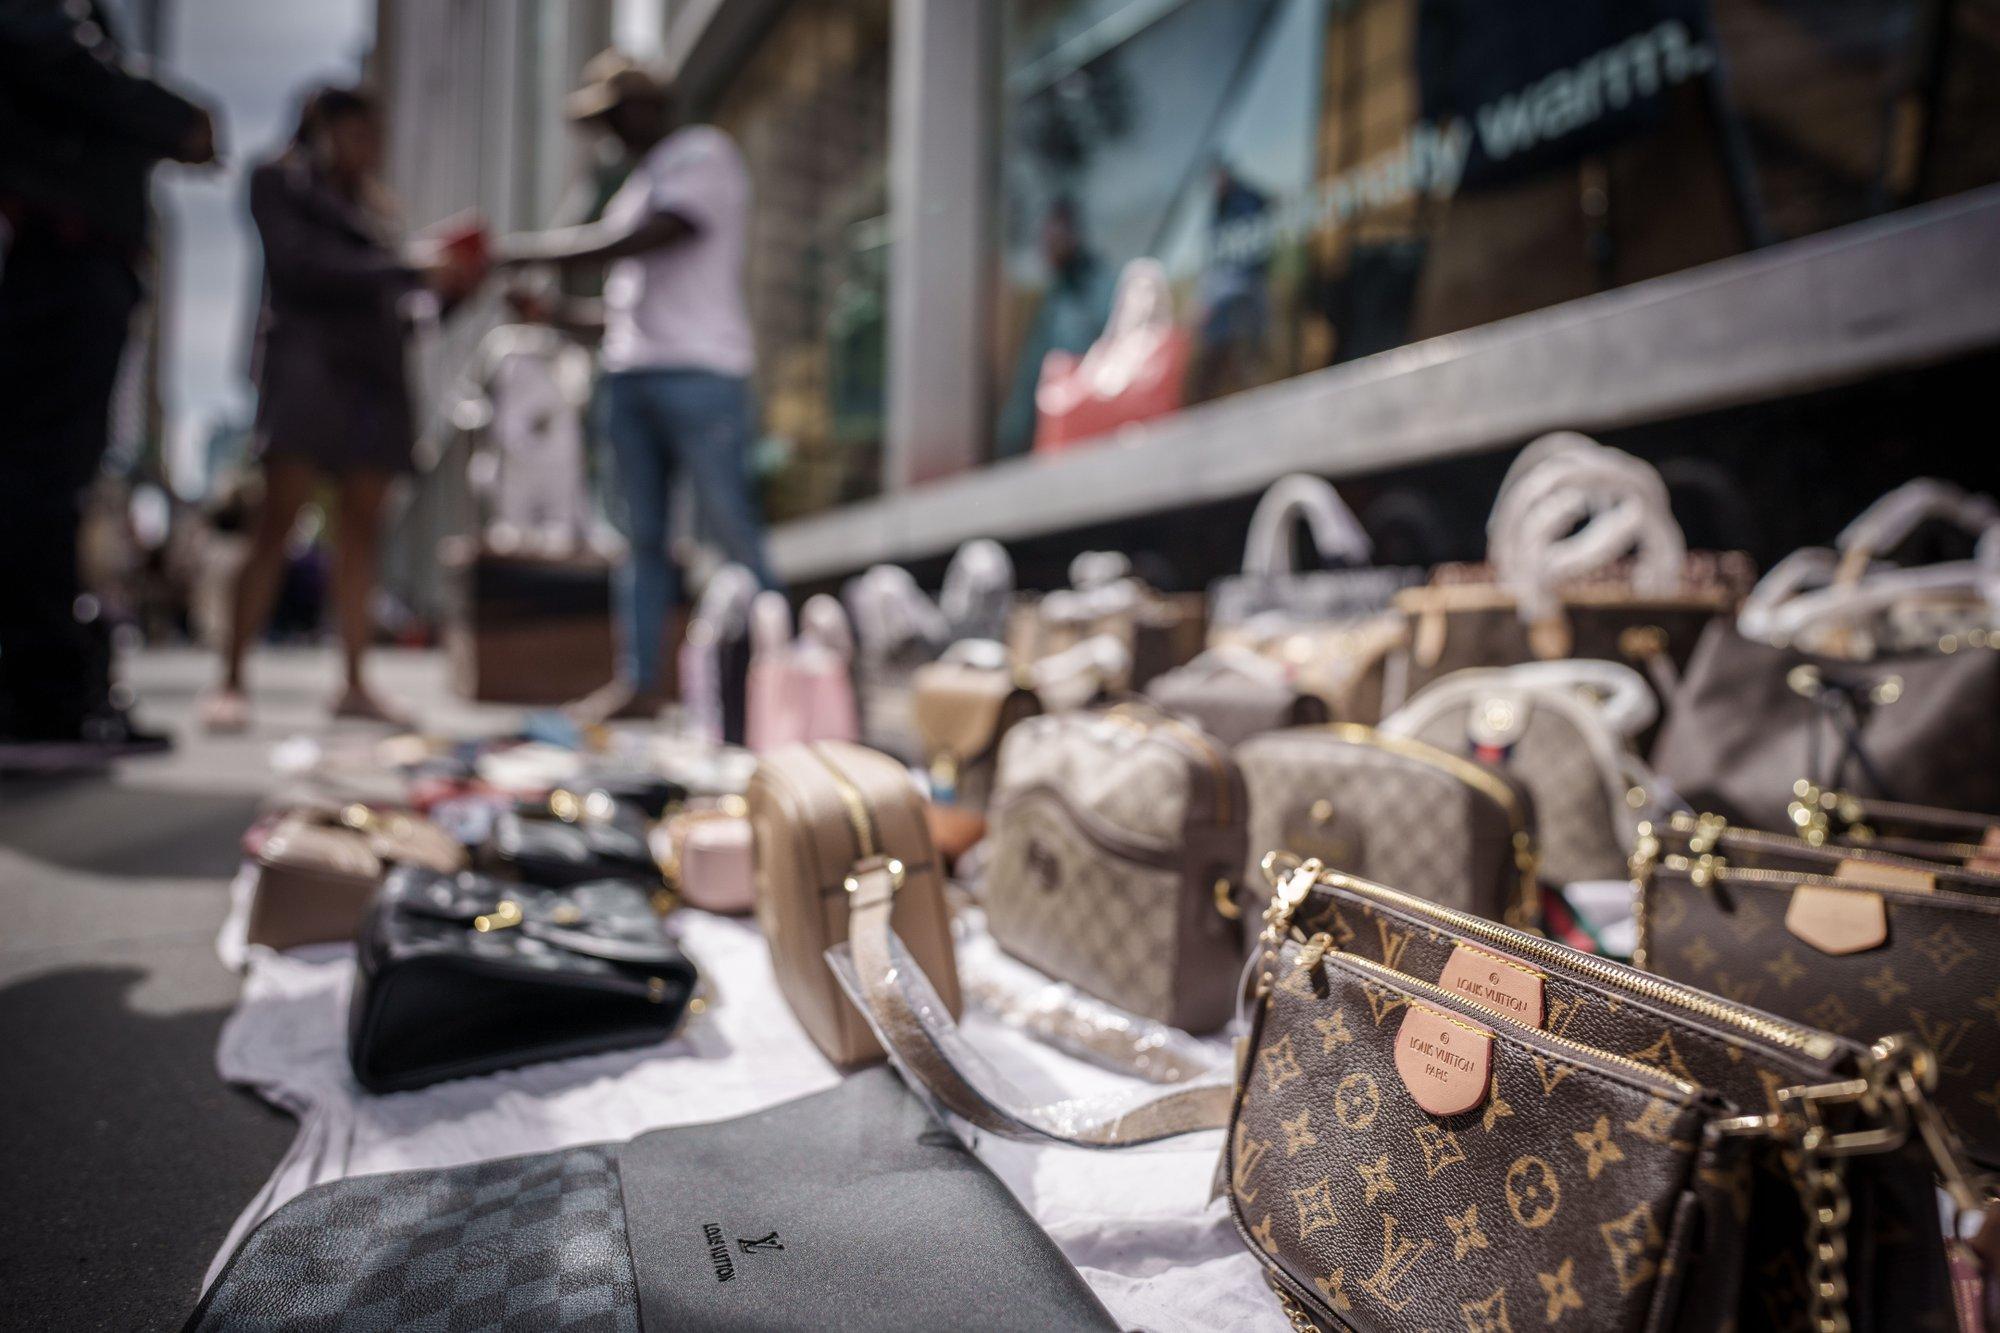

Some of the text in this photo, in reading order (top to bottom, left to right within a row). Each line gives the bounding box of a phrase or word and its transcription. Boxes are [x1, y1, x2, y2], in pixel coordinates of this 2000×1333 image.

[1457, 976, 1528, 1013] LOUIS VUITTON
[1409, 1036, 1475, 1073] LOUIS VUITTON
[1425, 1063, 1449, 1083] PARIS
